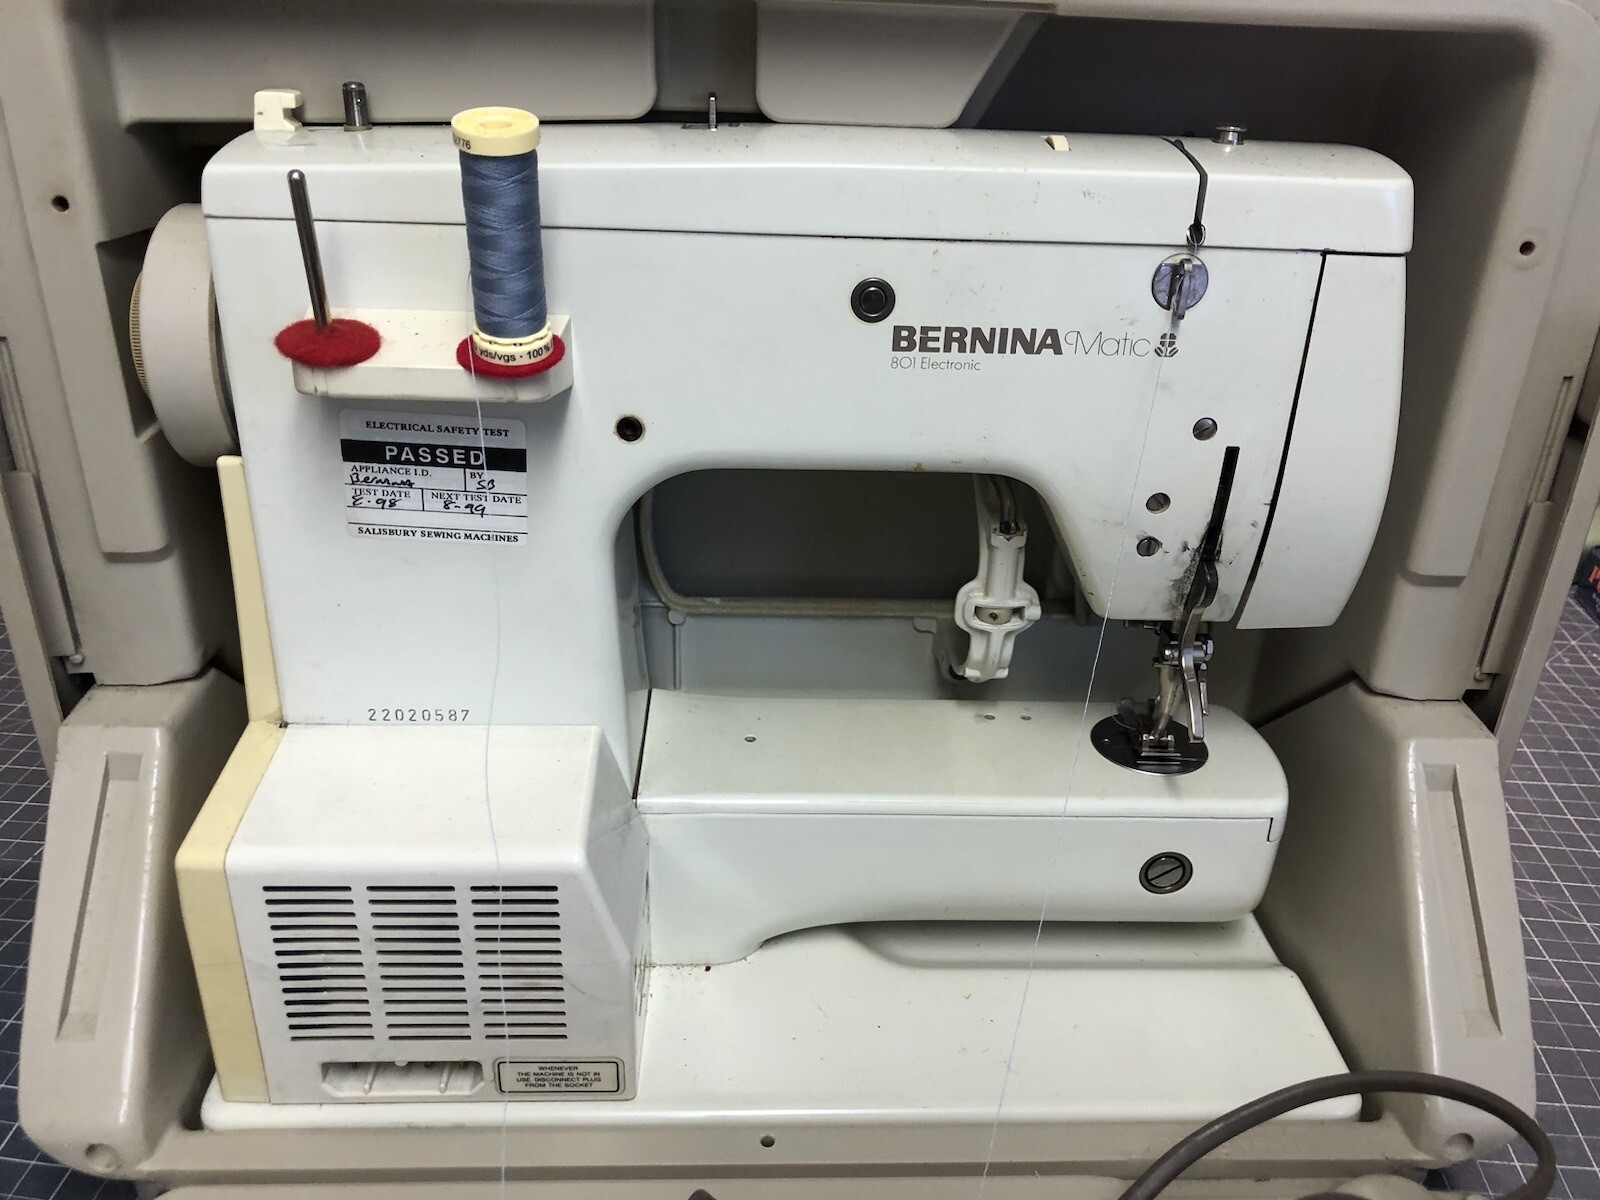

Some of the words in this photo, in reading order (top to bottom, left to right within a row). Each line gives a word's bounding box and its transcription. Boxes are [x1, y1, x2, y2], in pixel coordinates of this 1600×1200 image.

[892, 325, 1063, 355] BERNINA
[1064, 330, 1151, 358] Matic
[890, 356, 916, 370] 801
[920, 357, 981, 371] Electronic
[366, 421, 434, 432] ELECTRICAL
[437, 425, 480, 435] SAFETY
[482, 428, 510, 437] TEST
[385, 446, 484, 465] PASSED
[351, 465, 410, 476] APPLIANCE
[414, 468, 432, 477] I.D.
[470, 471, 484, 480] BY
[352, 487, 378, 496] TEST
[382, 489, 411, 498] DATE
[431, 492, 461, 501] NEXT
[463, 493, 488, 502] TEST
[492, 495, 522, 504] DATE
[358, 526, 417, 537] SALISBURY
[420, 530, 461, 540] SEWING
[464, 532, 519, 543] MACHINES
[367, 708, 470, 722] 22020587
